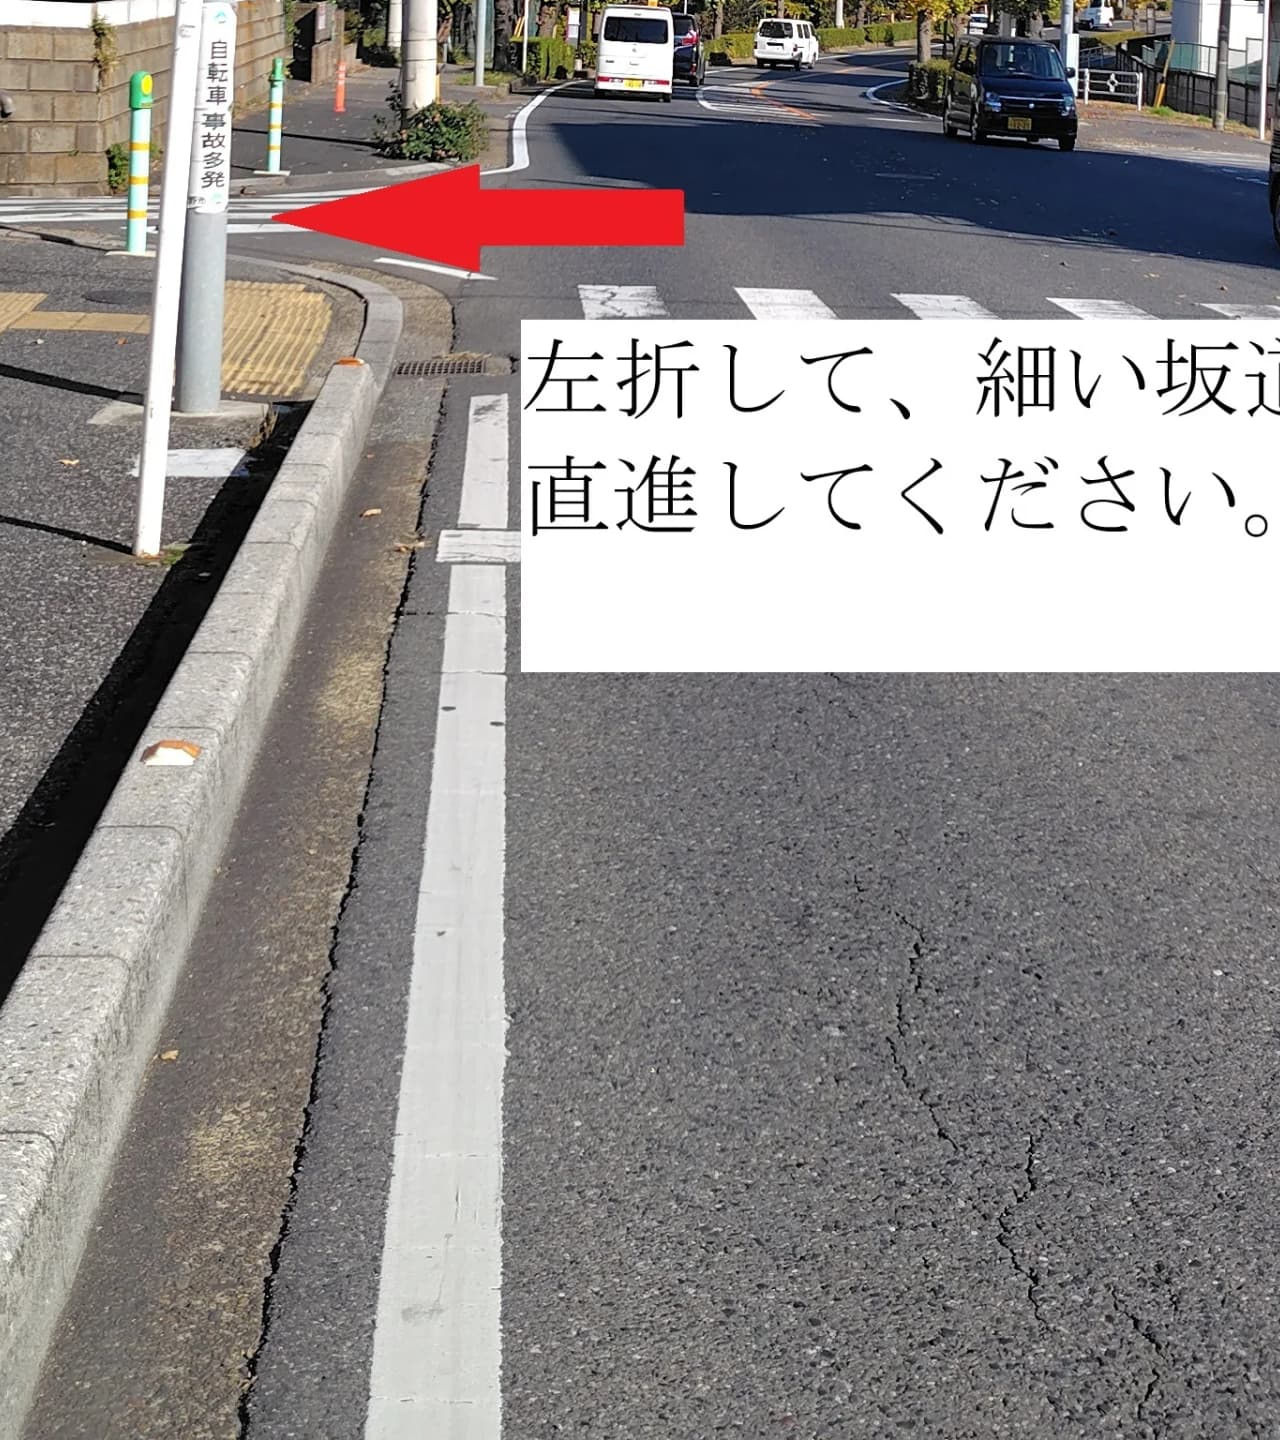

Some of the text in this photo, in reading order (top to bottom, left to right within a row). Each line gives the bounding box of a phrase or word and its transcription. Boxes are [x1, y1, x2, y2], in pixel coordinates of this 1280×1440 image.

[200, 39, 229, 189] 自転車事故多発
